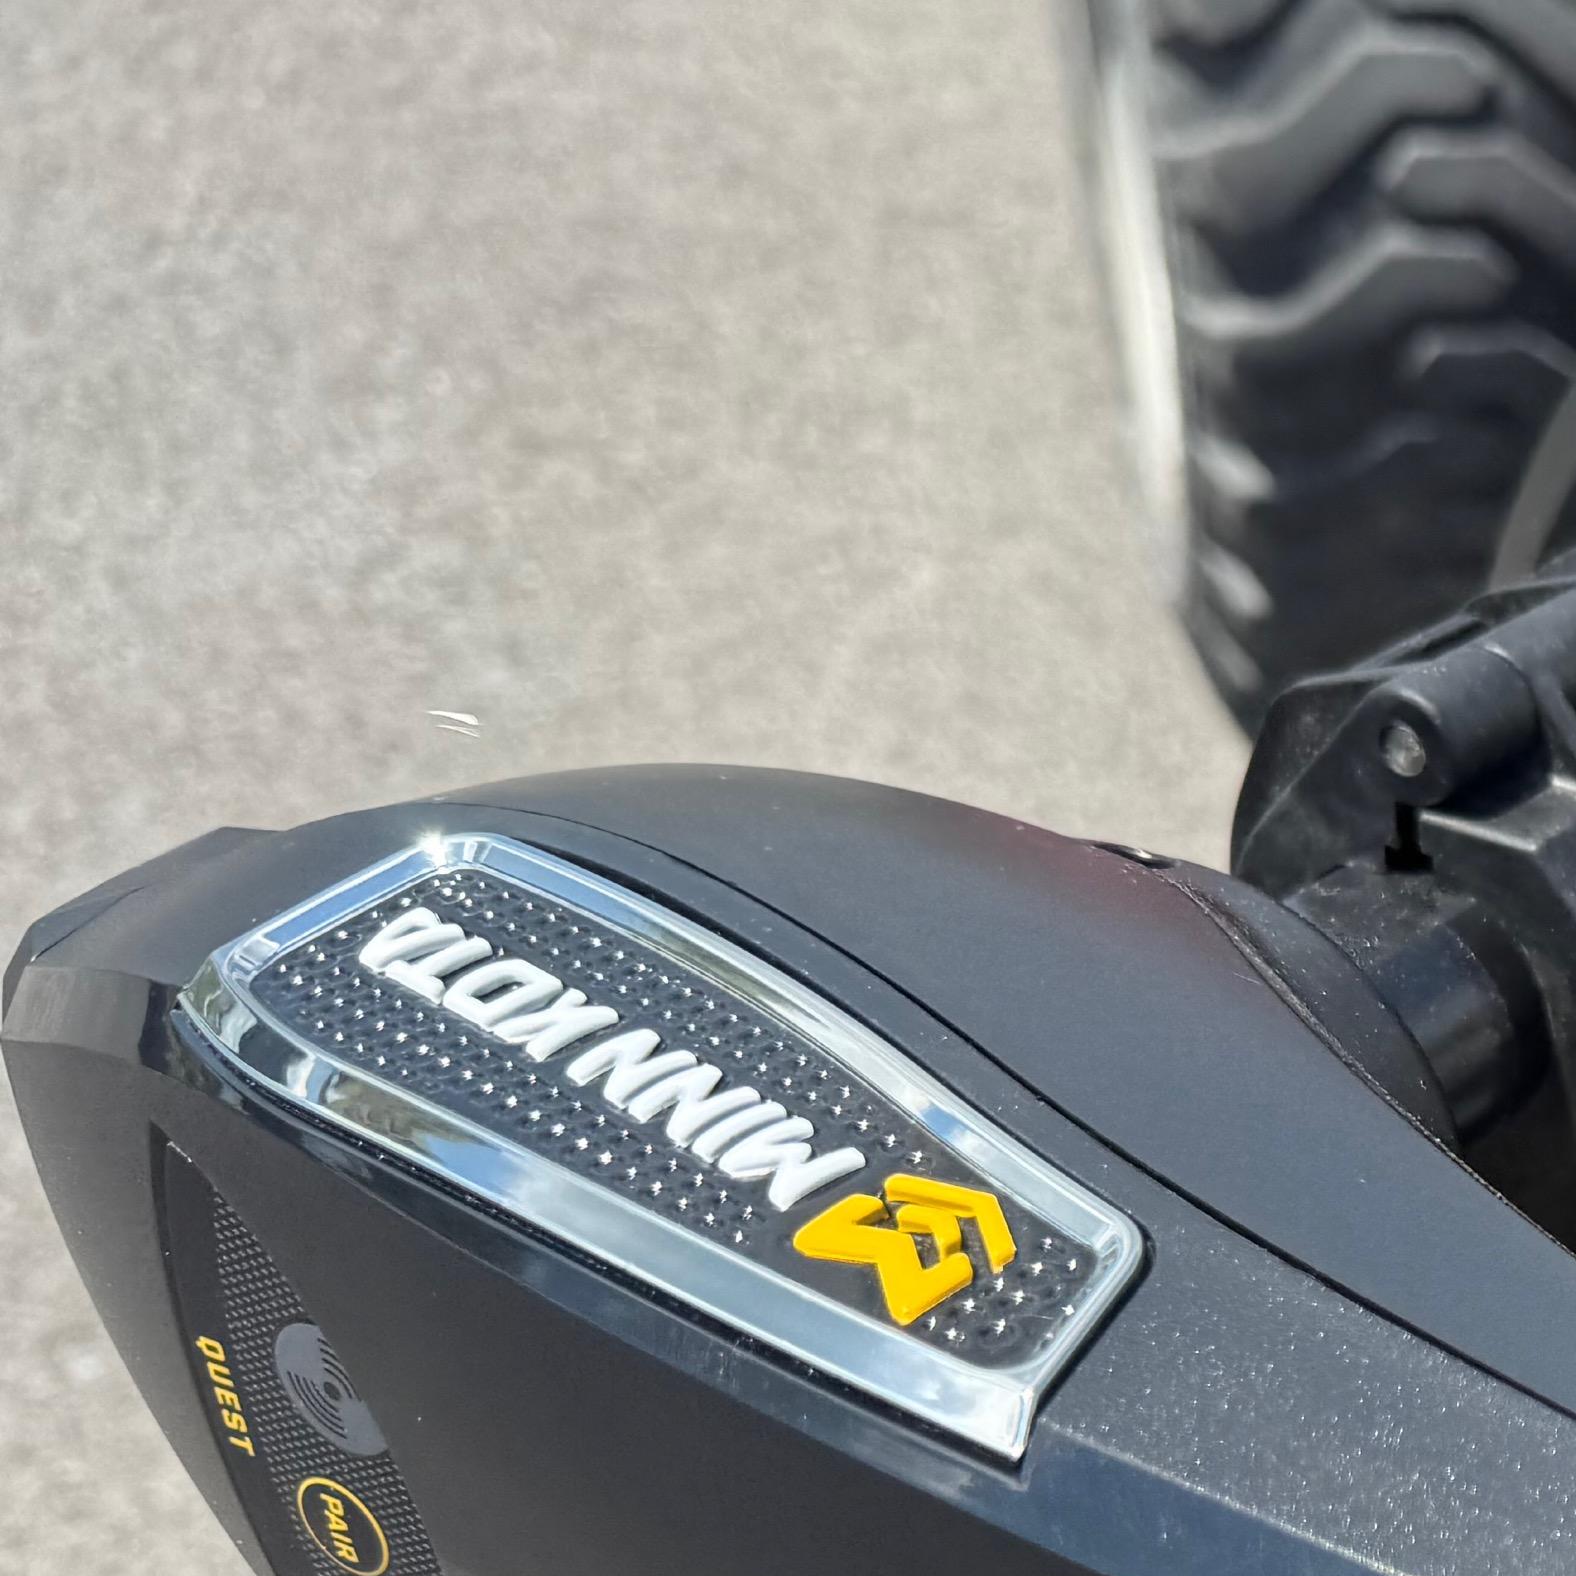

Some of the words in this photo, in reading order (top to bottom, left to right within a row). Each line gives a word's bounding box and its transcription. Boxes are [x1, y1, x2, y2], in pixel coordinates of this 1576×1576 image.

[357, 906, 620, 1063] KOTA
[567, 1027, 866, 1212] MINN
[195, 1335, 255, 1457] QUEST
[319, 1493, 360, 1565] PAIR
